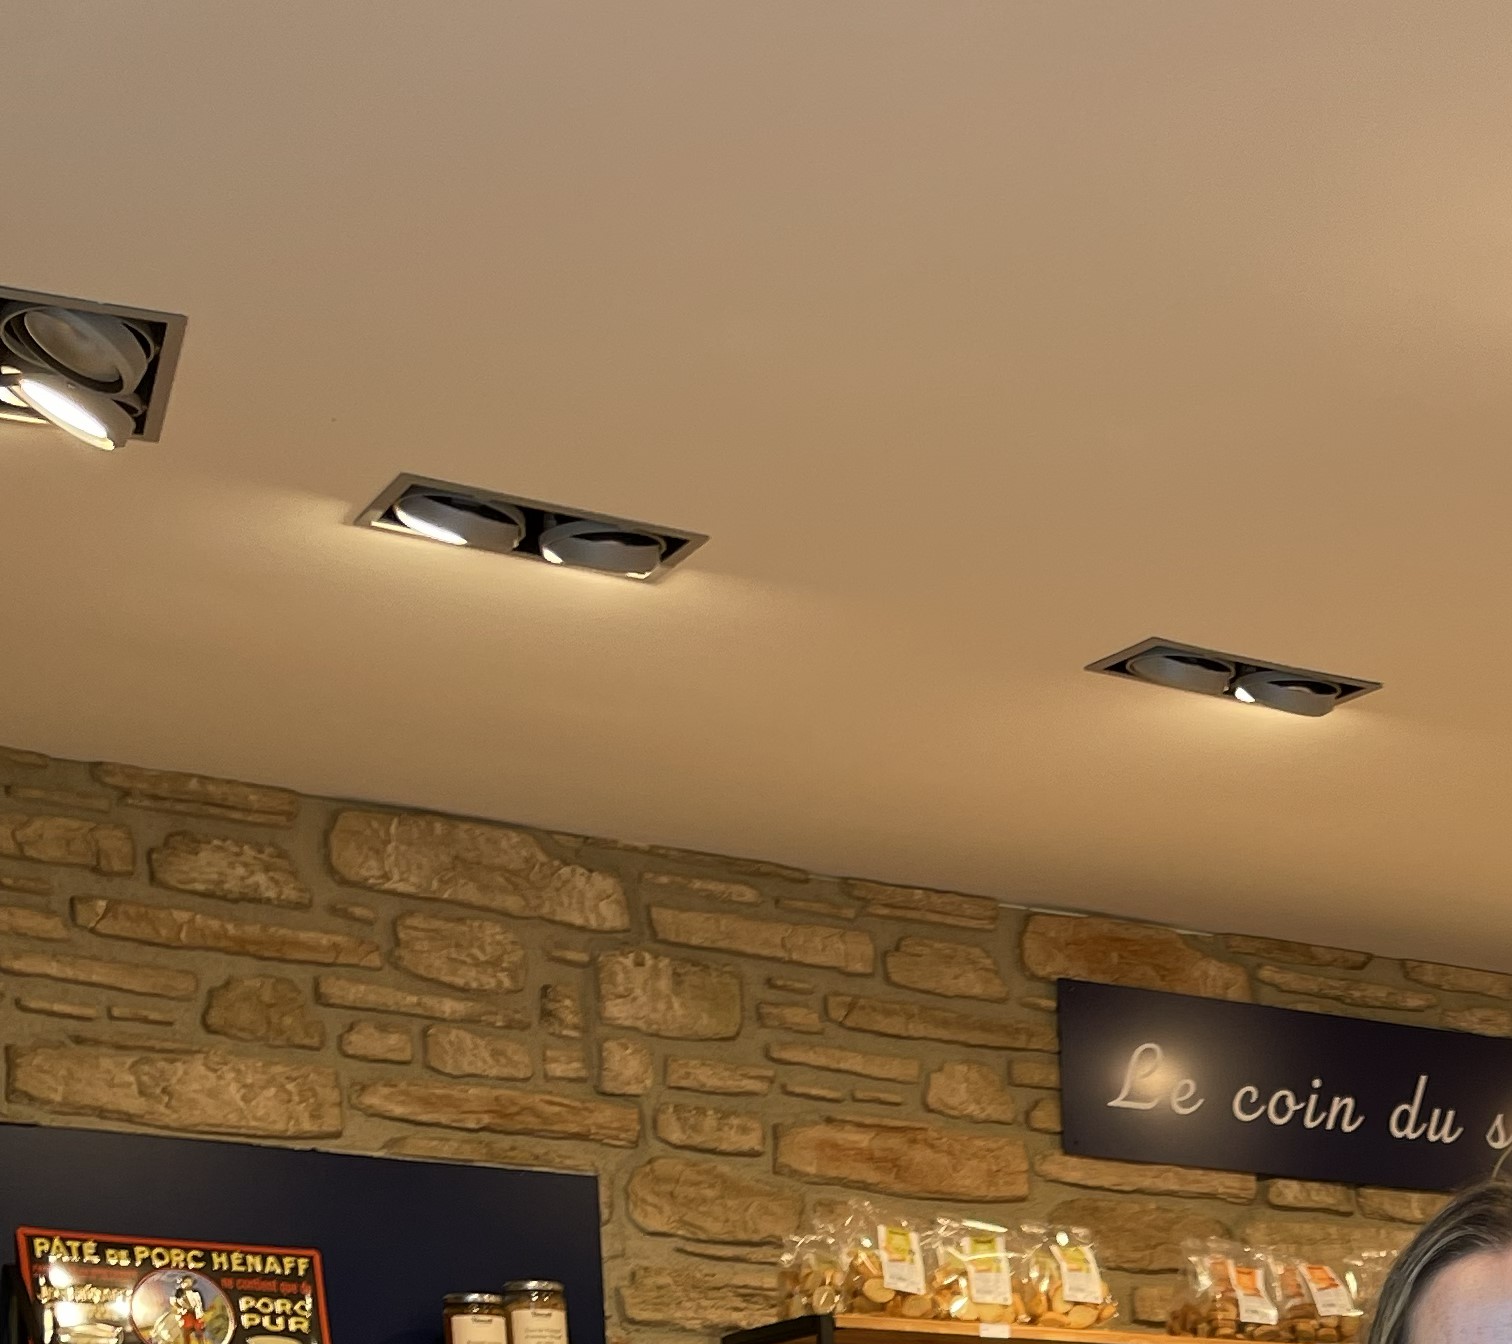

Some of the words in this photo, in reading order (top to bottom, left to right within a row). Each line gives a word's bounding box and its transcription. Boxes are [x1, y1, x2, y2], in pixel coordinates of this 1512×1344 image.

[1107, 1042, 1205, 1115] Le
[1231, 1077, 1365, 1134] coin
[1388, 1074, 1465, 1145] du
[33, 1236, 100, 1263] PÂTÉ
[133, 1245, 205, 1269] PORC
[212, 1252, 311, 1277] HÉNAFF
[238, 1297, 313, 1317] PORC
[241, 1313, 312, 1335] PUR
